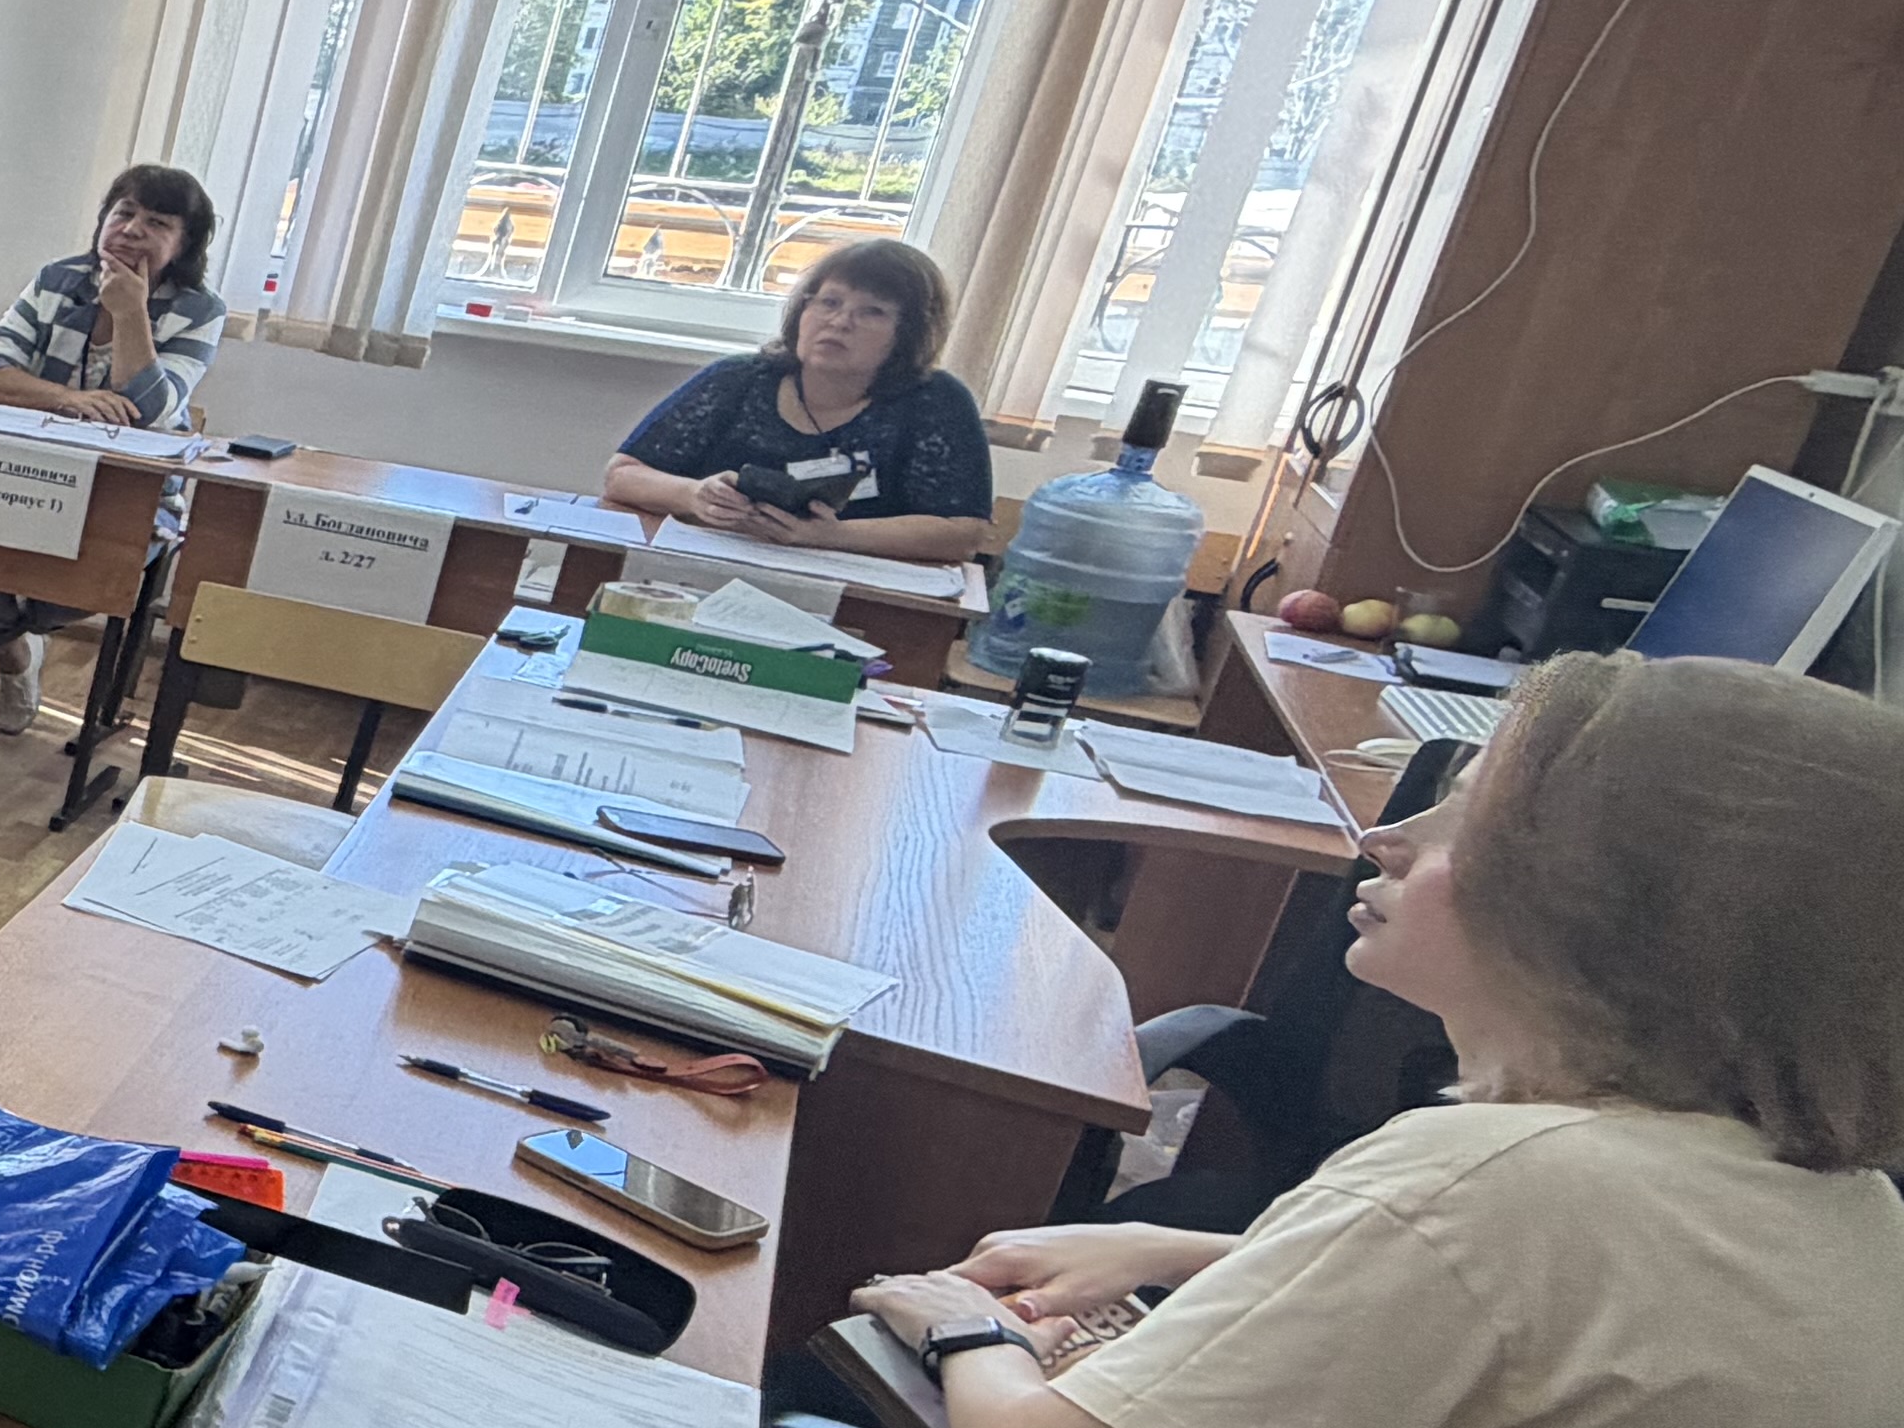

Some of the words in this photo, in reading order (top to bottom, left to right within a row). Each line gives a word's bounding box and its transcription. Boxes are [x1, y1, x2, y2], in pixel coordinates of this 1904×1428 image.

[49, 498, 64, 514] 1)
[315, 513, 430, 550] Богдановича
[338, 551, 376, 569] 2/27
[670, 646, 752, 683] SvetoCopy
